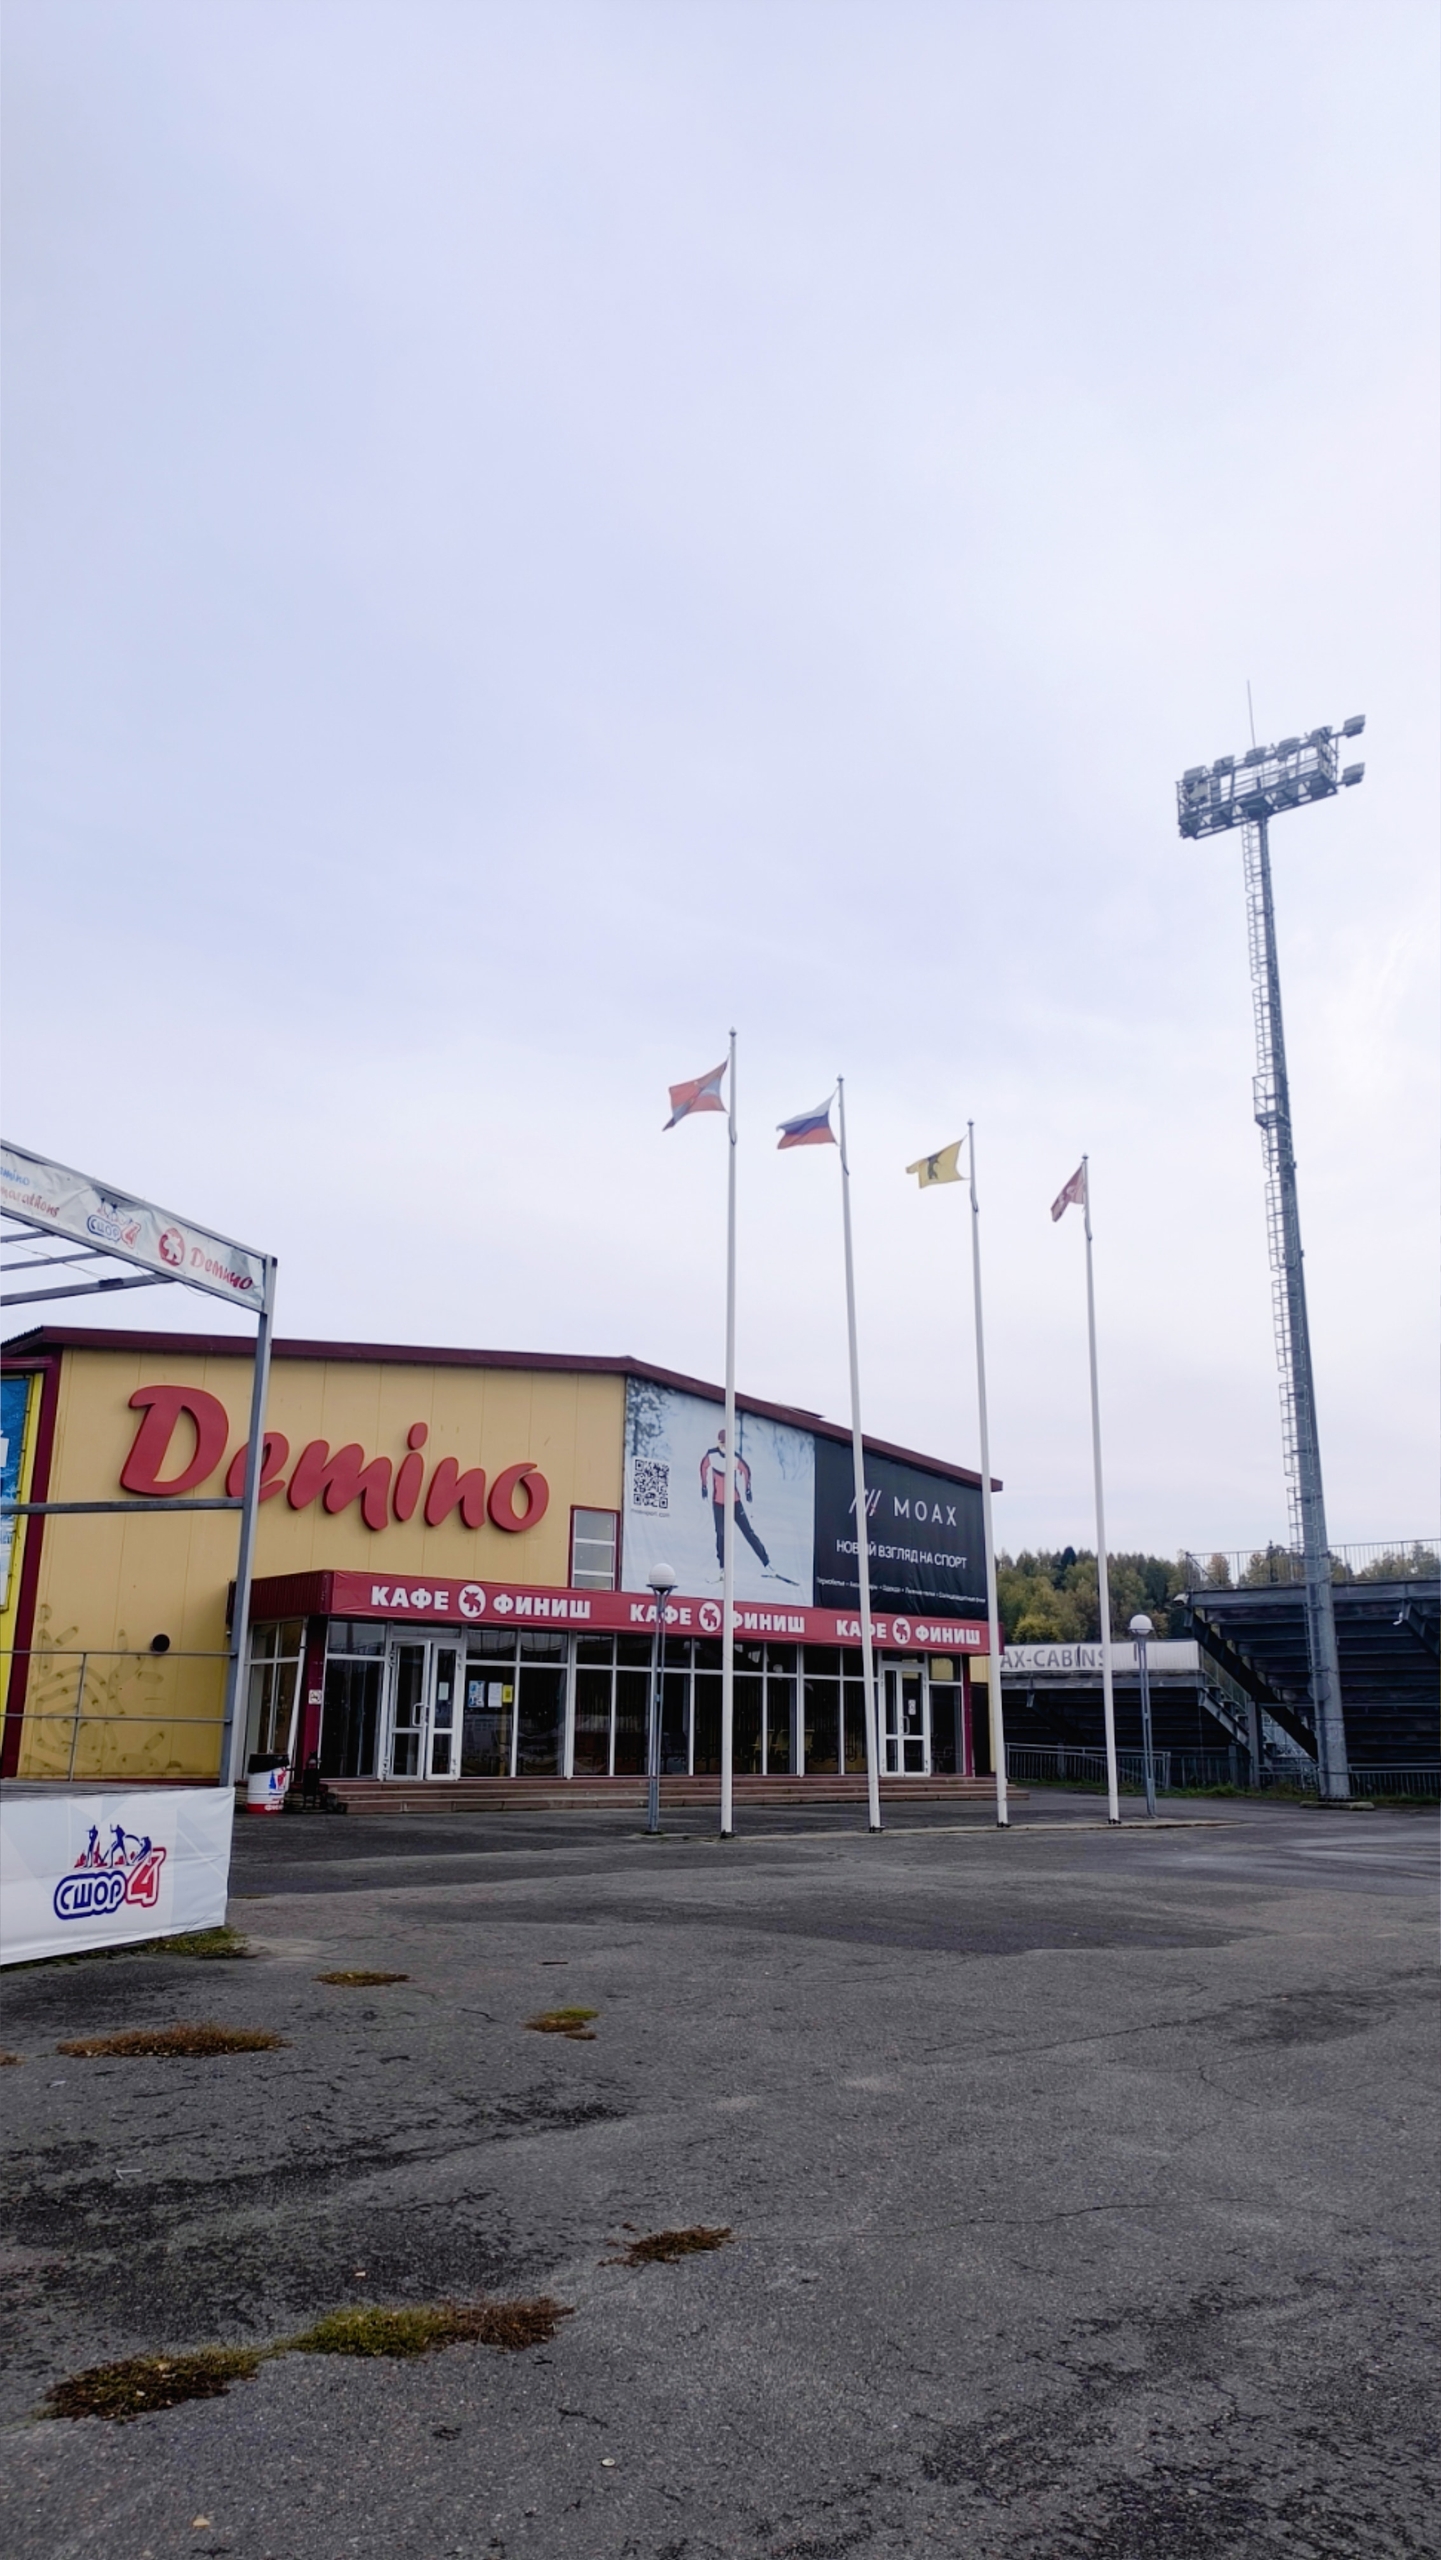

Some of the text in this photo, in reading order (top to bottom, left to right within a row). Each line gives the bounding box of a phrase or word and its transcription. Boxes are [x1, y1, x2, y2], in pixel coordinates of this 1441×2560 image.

[119, 1384, 550, 1532] Demino
[893, 1496, 957, 1527] MOAX
[836, 1539, 967, 1569] НОВЙ ВЗГЛЯД НА СПОРТ
[370, 1586, 591, 1619] КАФЕ ФИНИШ
[630, 1604, 692, 1625] КАФЕ
[915, 1625, 980, 1645] ФИНИШ
[57, 1851, 163, 1914] СШОР 4
